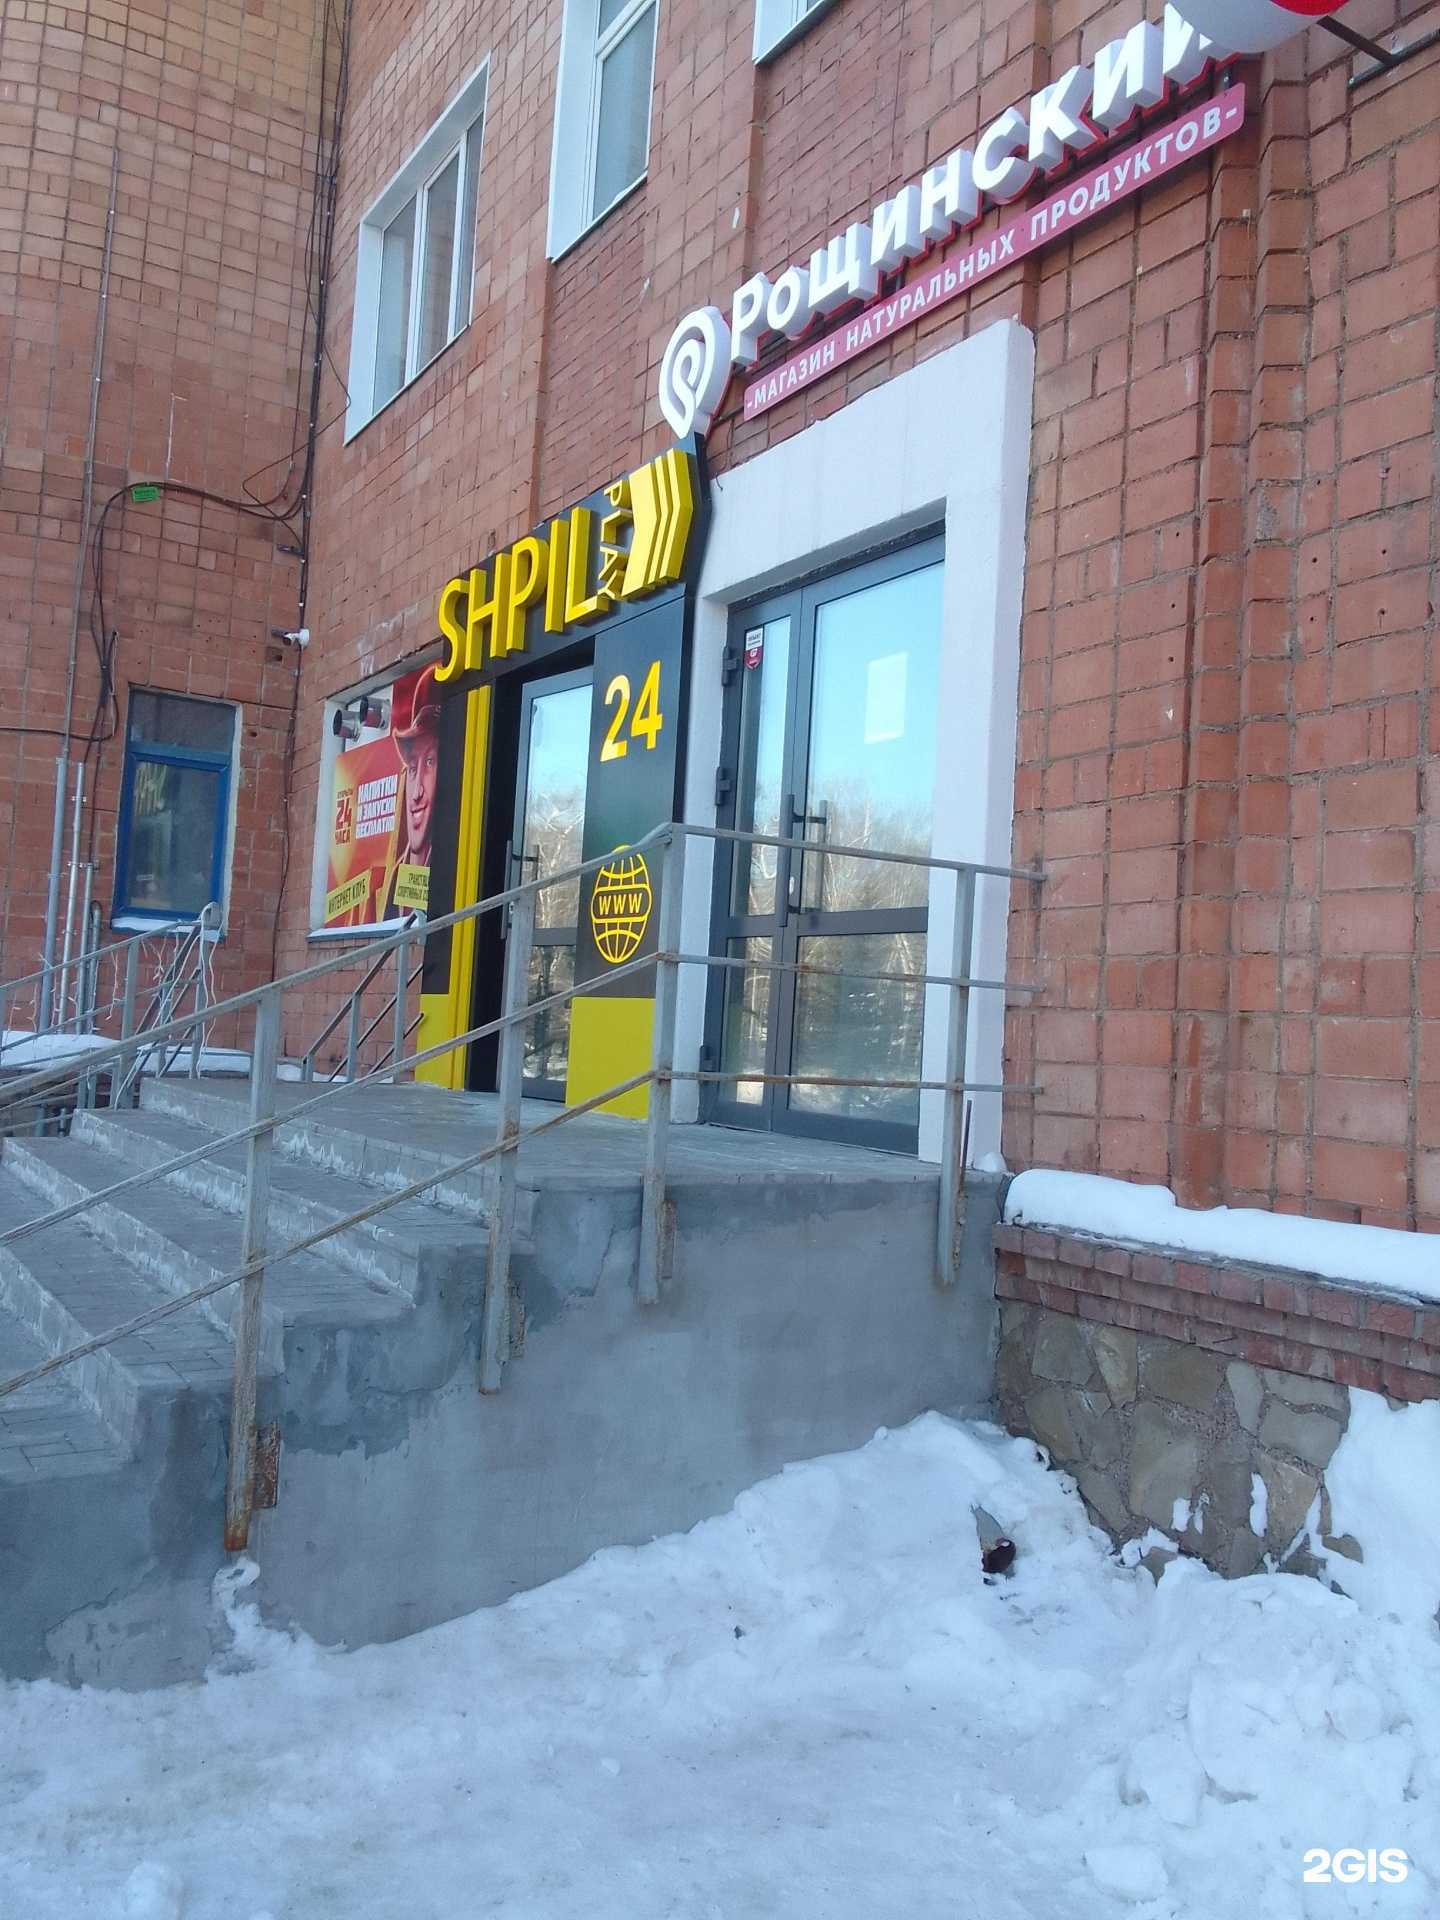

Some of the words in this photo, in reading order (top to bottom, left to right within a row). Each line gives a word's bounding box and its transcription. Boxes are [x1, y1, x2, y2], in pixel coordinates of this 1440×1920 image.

[846, 228, 1015, 354] НАТУРАЛЬНЫХ
[434, 506, 608, 682] SHPIL
[600, 660, 662, 762] 24
[335, 797, 352, 830] 24
